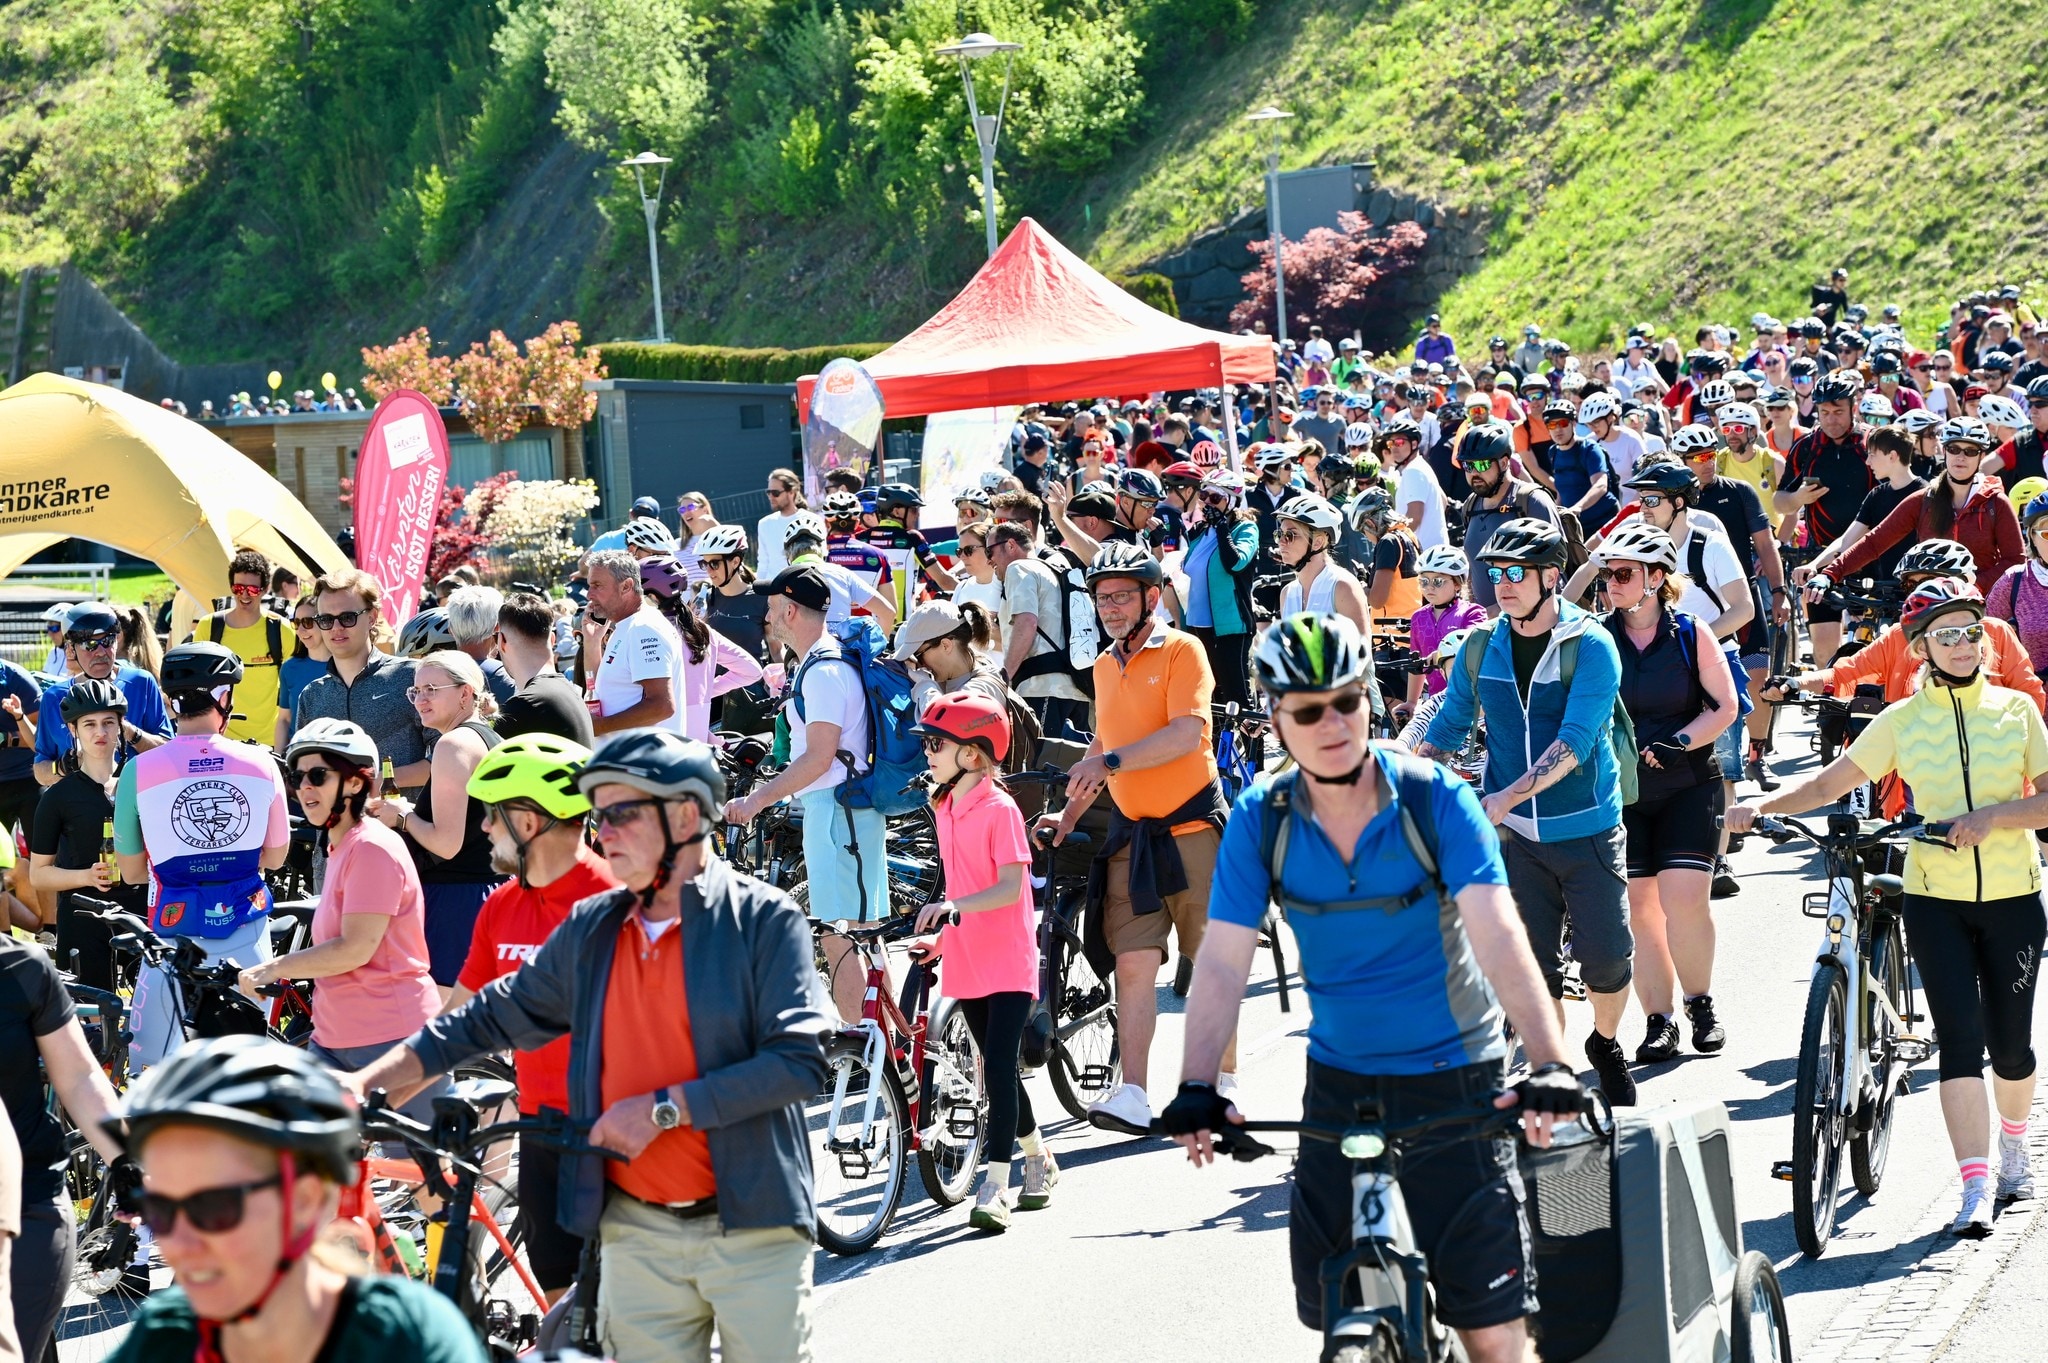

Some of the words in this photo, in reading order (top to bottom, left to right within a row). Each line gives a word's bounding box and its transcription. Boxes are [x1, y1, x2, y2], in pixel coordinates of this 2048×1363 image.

[0, 505, 94, 525] tnerjugendkarte.at
[173, 781, 225, 810] GENTLEMENS
[228, 786, 246, 806] CLUB
[184, 832, 240, 849] FERGARETEN
[204, 913, 236, 927] HUSS
